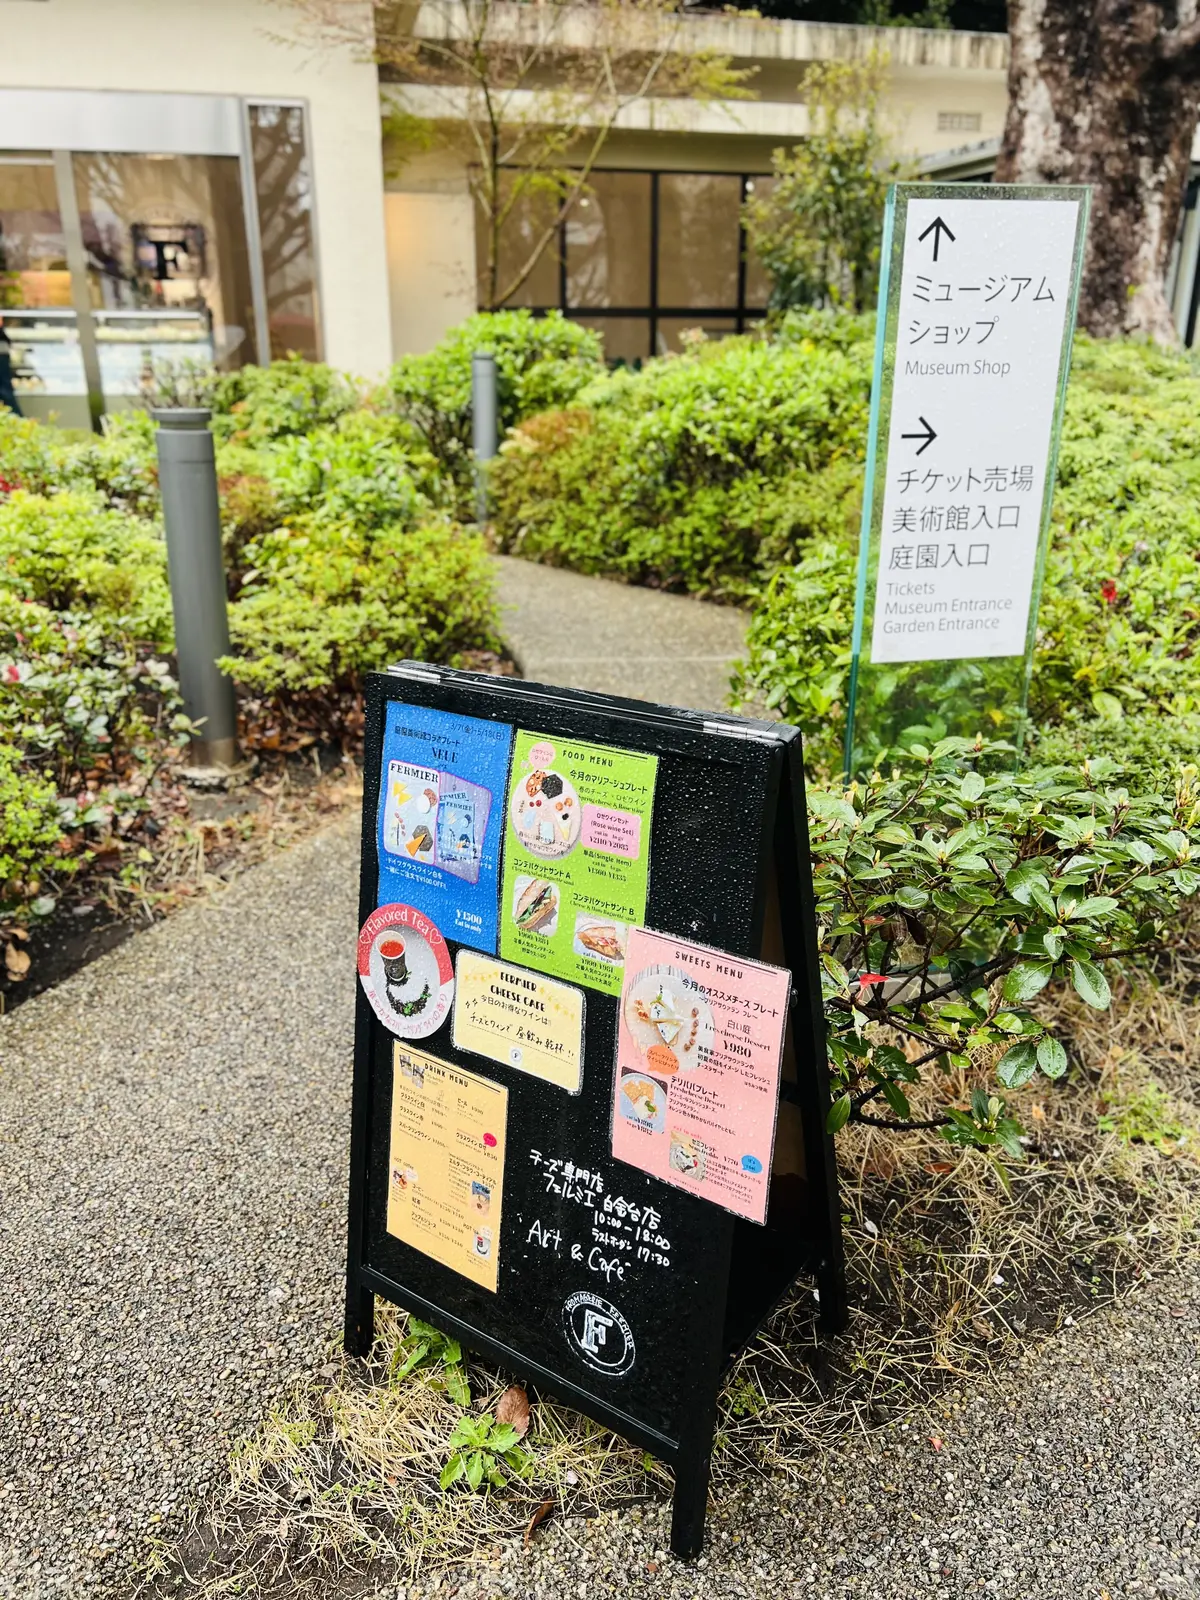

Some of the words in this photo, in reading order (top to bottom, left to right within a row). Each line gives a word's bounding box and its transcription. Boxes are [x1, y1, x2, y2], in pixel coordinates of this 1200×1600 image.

[912, 274, 1055, 303] ミュージアム
[909, 315, 1000, 345] ショップ
[905, 360, 970, 376] Museum
[974, 359, 1011, 378] Shop
[897, 465, 1034, 494] チケット売場
[892, 504, 1021, 533] 美術館入口
[889, 543, 990, 570] 庭園入口
[886, 581, 936, 596] Tickets
[884, 601, 948, 615] Museum
[951, 598, 1013, 613] Entrance
[883, 618, 935, 634] Garden
[938, 616, 1000, 632] Entrance
[562, 749, 585, 762] FOOD
[589, 755, 613, 767] MENU
[390, 762, 439, 783] FERMIER
[565, 871, 571, 879] A
[366, 908, 408, 936] Flavored
[411, 910, 429, 936] Tea
[628, 908, 635, 916] B
[675, 951, 712, 970] SWEETS
[716, 965, 744, 980] MENU
[500, 971, 537, 993] FERMIER
[681, 978, 751, 1008] 今月のオススメチーズ
[490, 984, 521, 1003] CHEESE
[523, 996, 546, 1013] CAFE
[727, 1019, 752, 1035] 白い庭
[723, 1039, 752, 1058] ¥980
[744, 1036, 771, 1052] Dessert
[424, 1062, 446, 1078] DRINK
[449, 1073, 469, 1088] MENU
[529, 1149, 604, 1193] チーズ専門店
[543, 1173, 596, 1208] フェルミエ
[526, 1219, 563, 1251] Art
[570, 1243, 584, 1261] &
[637, 1246, 671, 1267] 17:30
[580, 1308, 614, 1354] F
